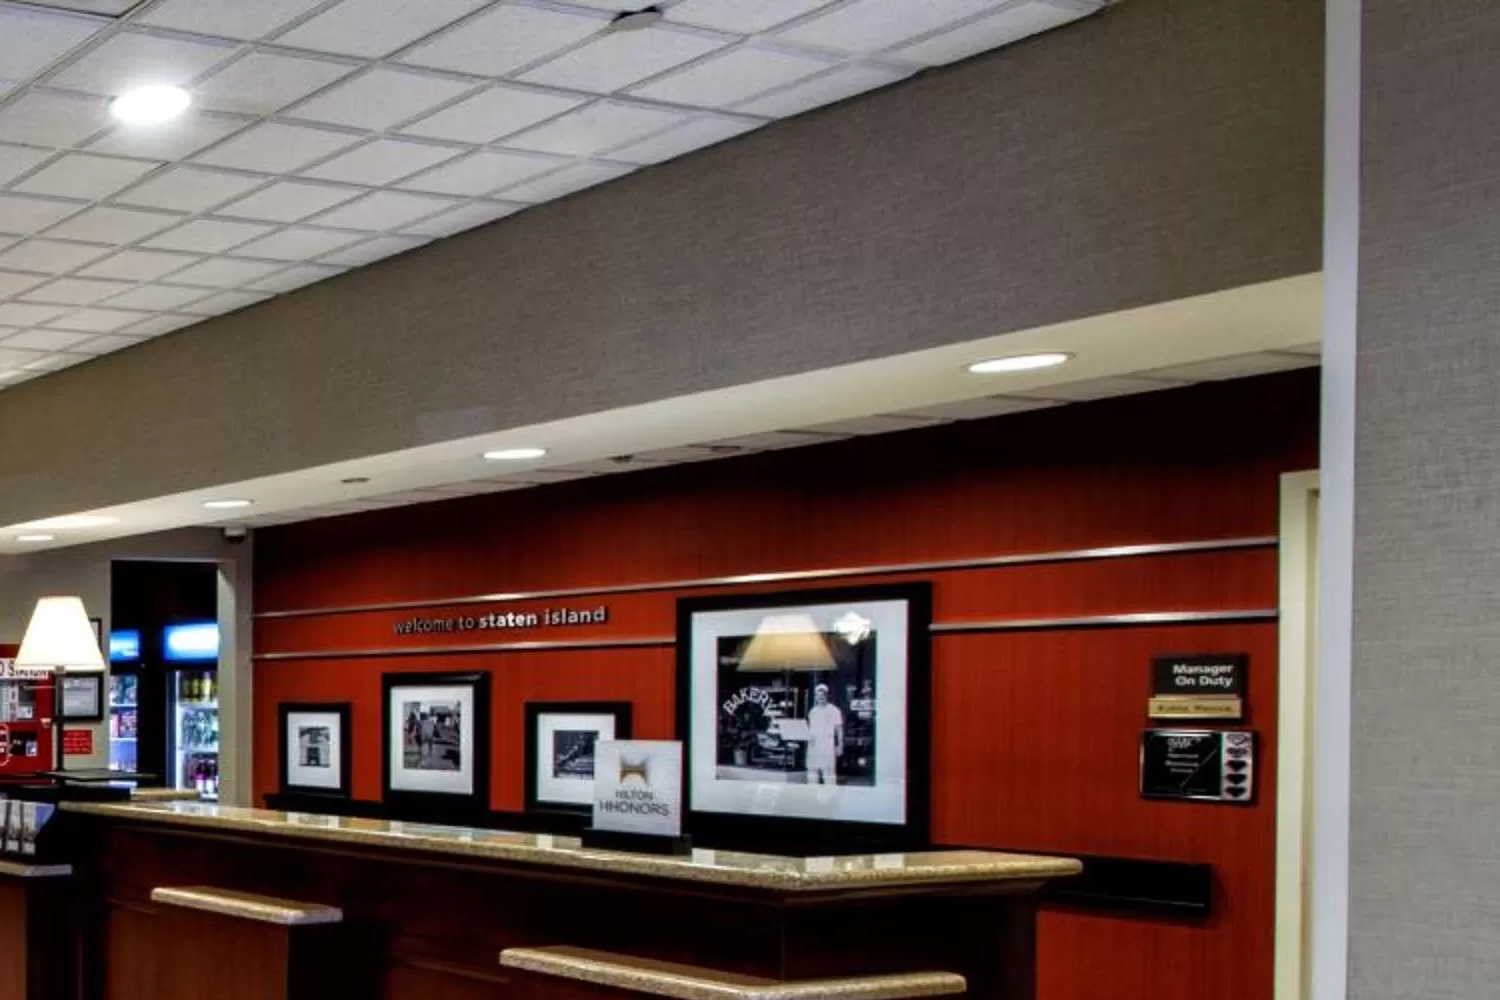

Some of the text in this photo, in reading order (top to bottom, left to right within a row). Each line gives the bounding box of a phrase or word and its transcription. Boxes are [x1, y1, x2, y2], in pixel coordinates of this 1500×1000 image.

[393, 605, 605, 633] welcome to staten island
[1173, 664, 1234, 677] Manager
[1175, 675, 1233, 688] On Duty
[599, 800, 669, 816] HHONORS
